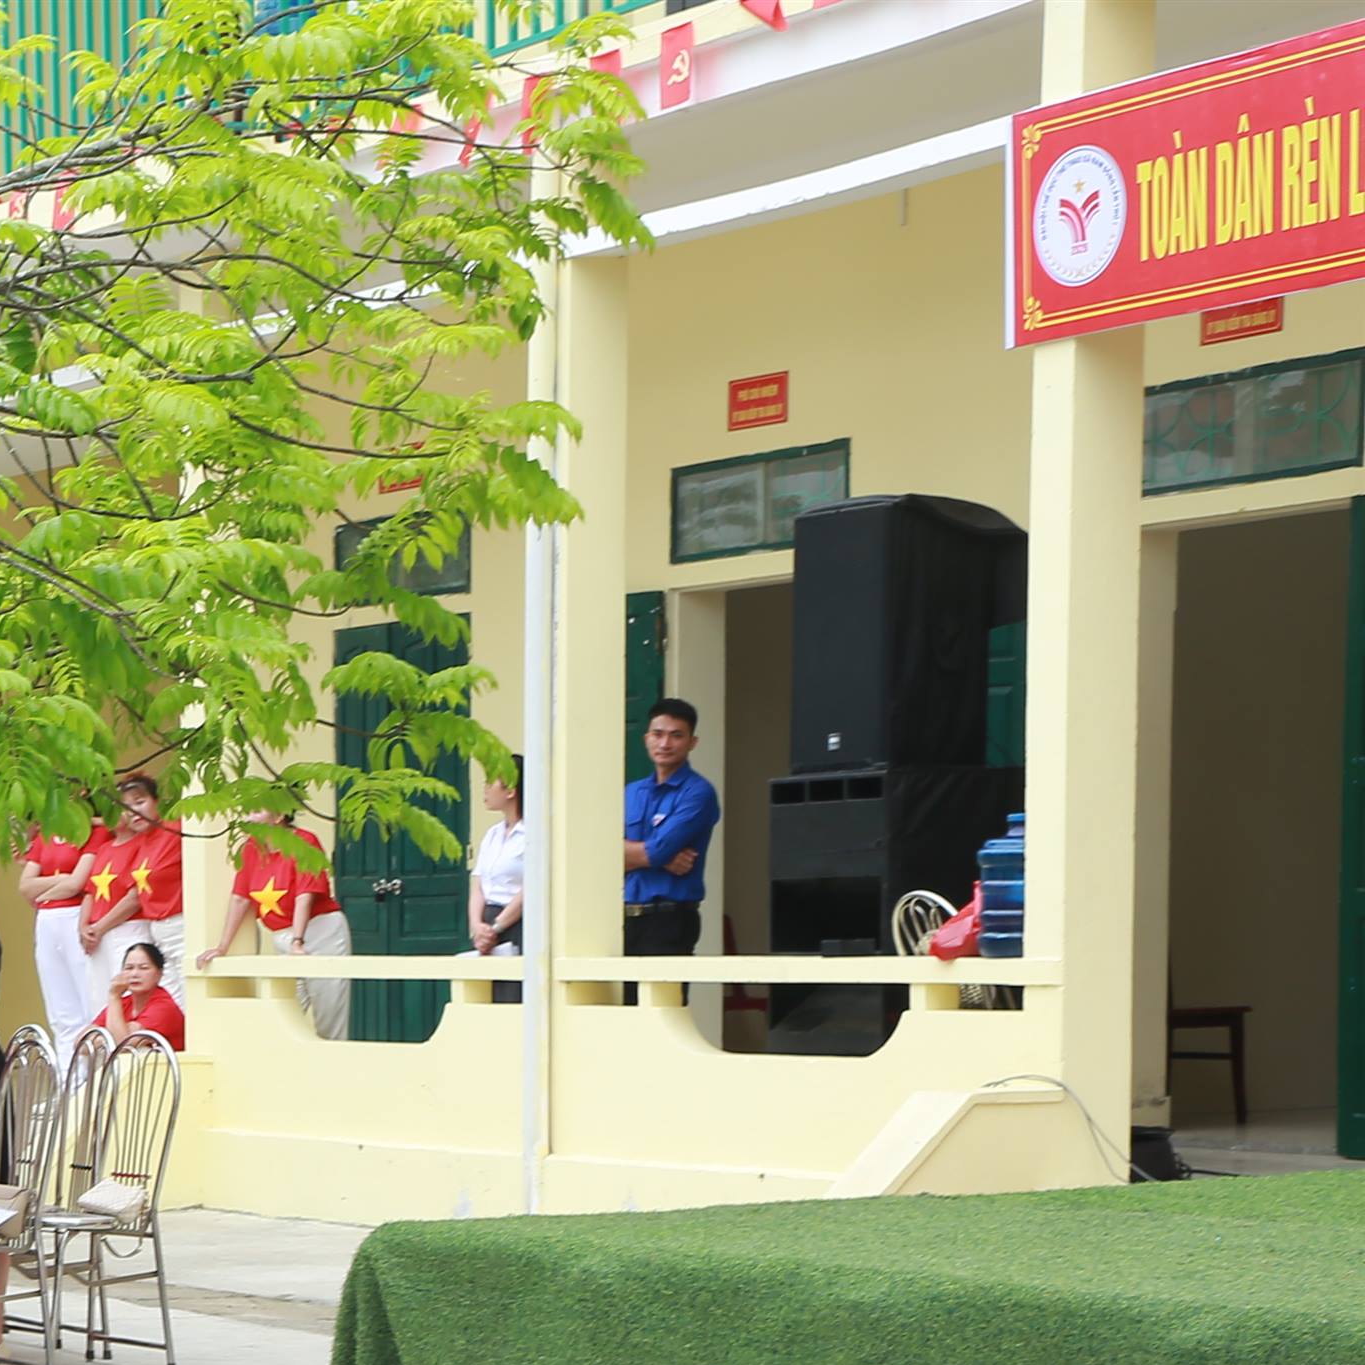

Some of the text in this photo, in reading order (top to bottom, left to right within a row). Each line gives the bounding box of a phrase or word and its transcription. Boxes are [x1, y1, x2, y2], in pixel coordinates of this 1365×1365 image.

[1136, 130, 1209, 262] TOÀN
[1215, 113, 1275, 246] DÂN
[1281, 96, 1342, 231] RÈN
